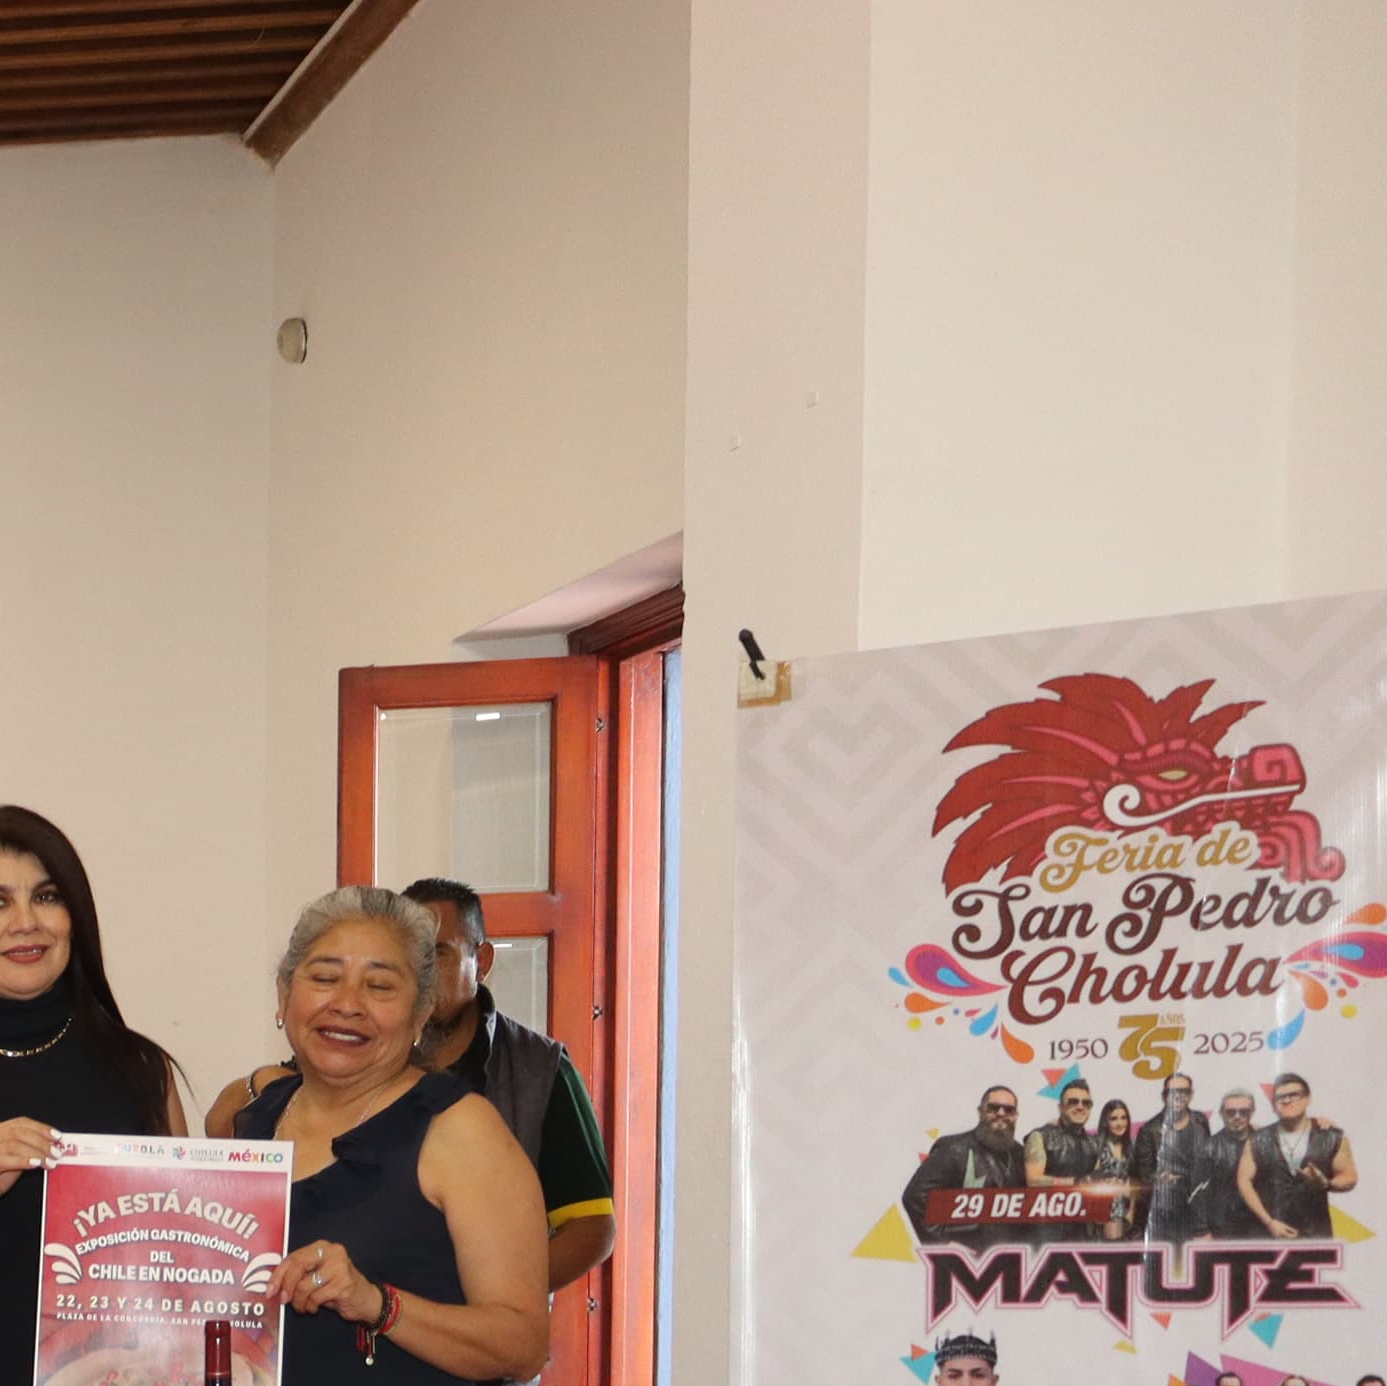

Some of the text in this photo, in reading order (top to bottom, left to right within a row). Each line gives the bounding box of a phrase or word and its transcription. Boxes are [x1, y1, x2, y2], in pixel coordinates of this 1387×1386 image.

[1040, 829, 1251, 893] Feria de
[952, 872, 1339, 960] San Pedro
[1001, 944, 1283, 1025] Cholula
[1049, 1014, 1264, 1080] 1950 75 2025
[74, 1188, 259, 1239] ¡YA ESTÁ AQUÍ!
[951, 1192, 1086, 1218] 29 DE AGO.
[76, 1228, 251, 1263] EXPOSICIÓN GASTRONÓMICA
[150, 1251, 173, 1263] DEL
[89, 1264, 234, 1285] CHILE EN NOGADA
[920, 1245, 1359, 1339] MATUTE
[56, 1294, 265, 1316] 22, 23 Y 24 DE AGOSTO
